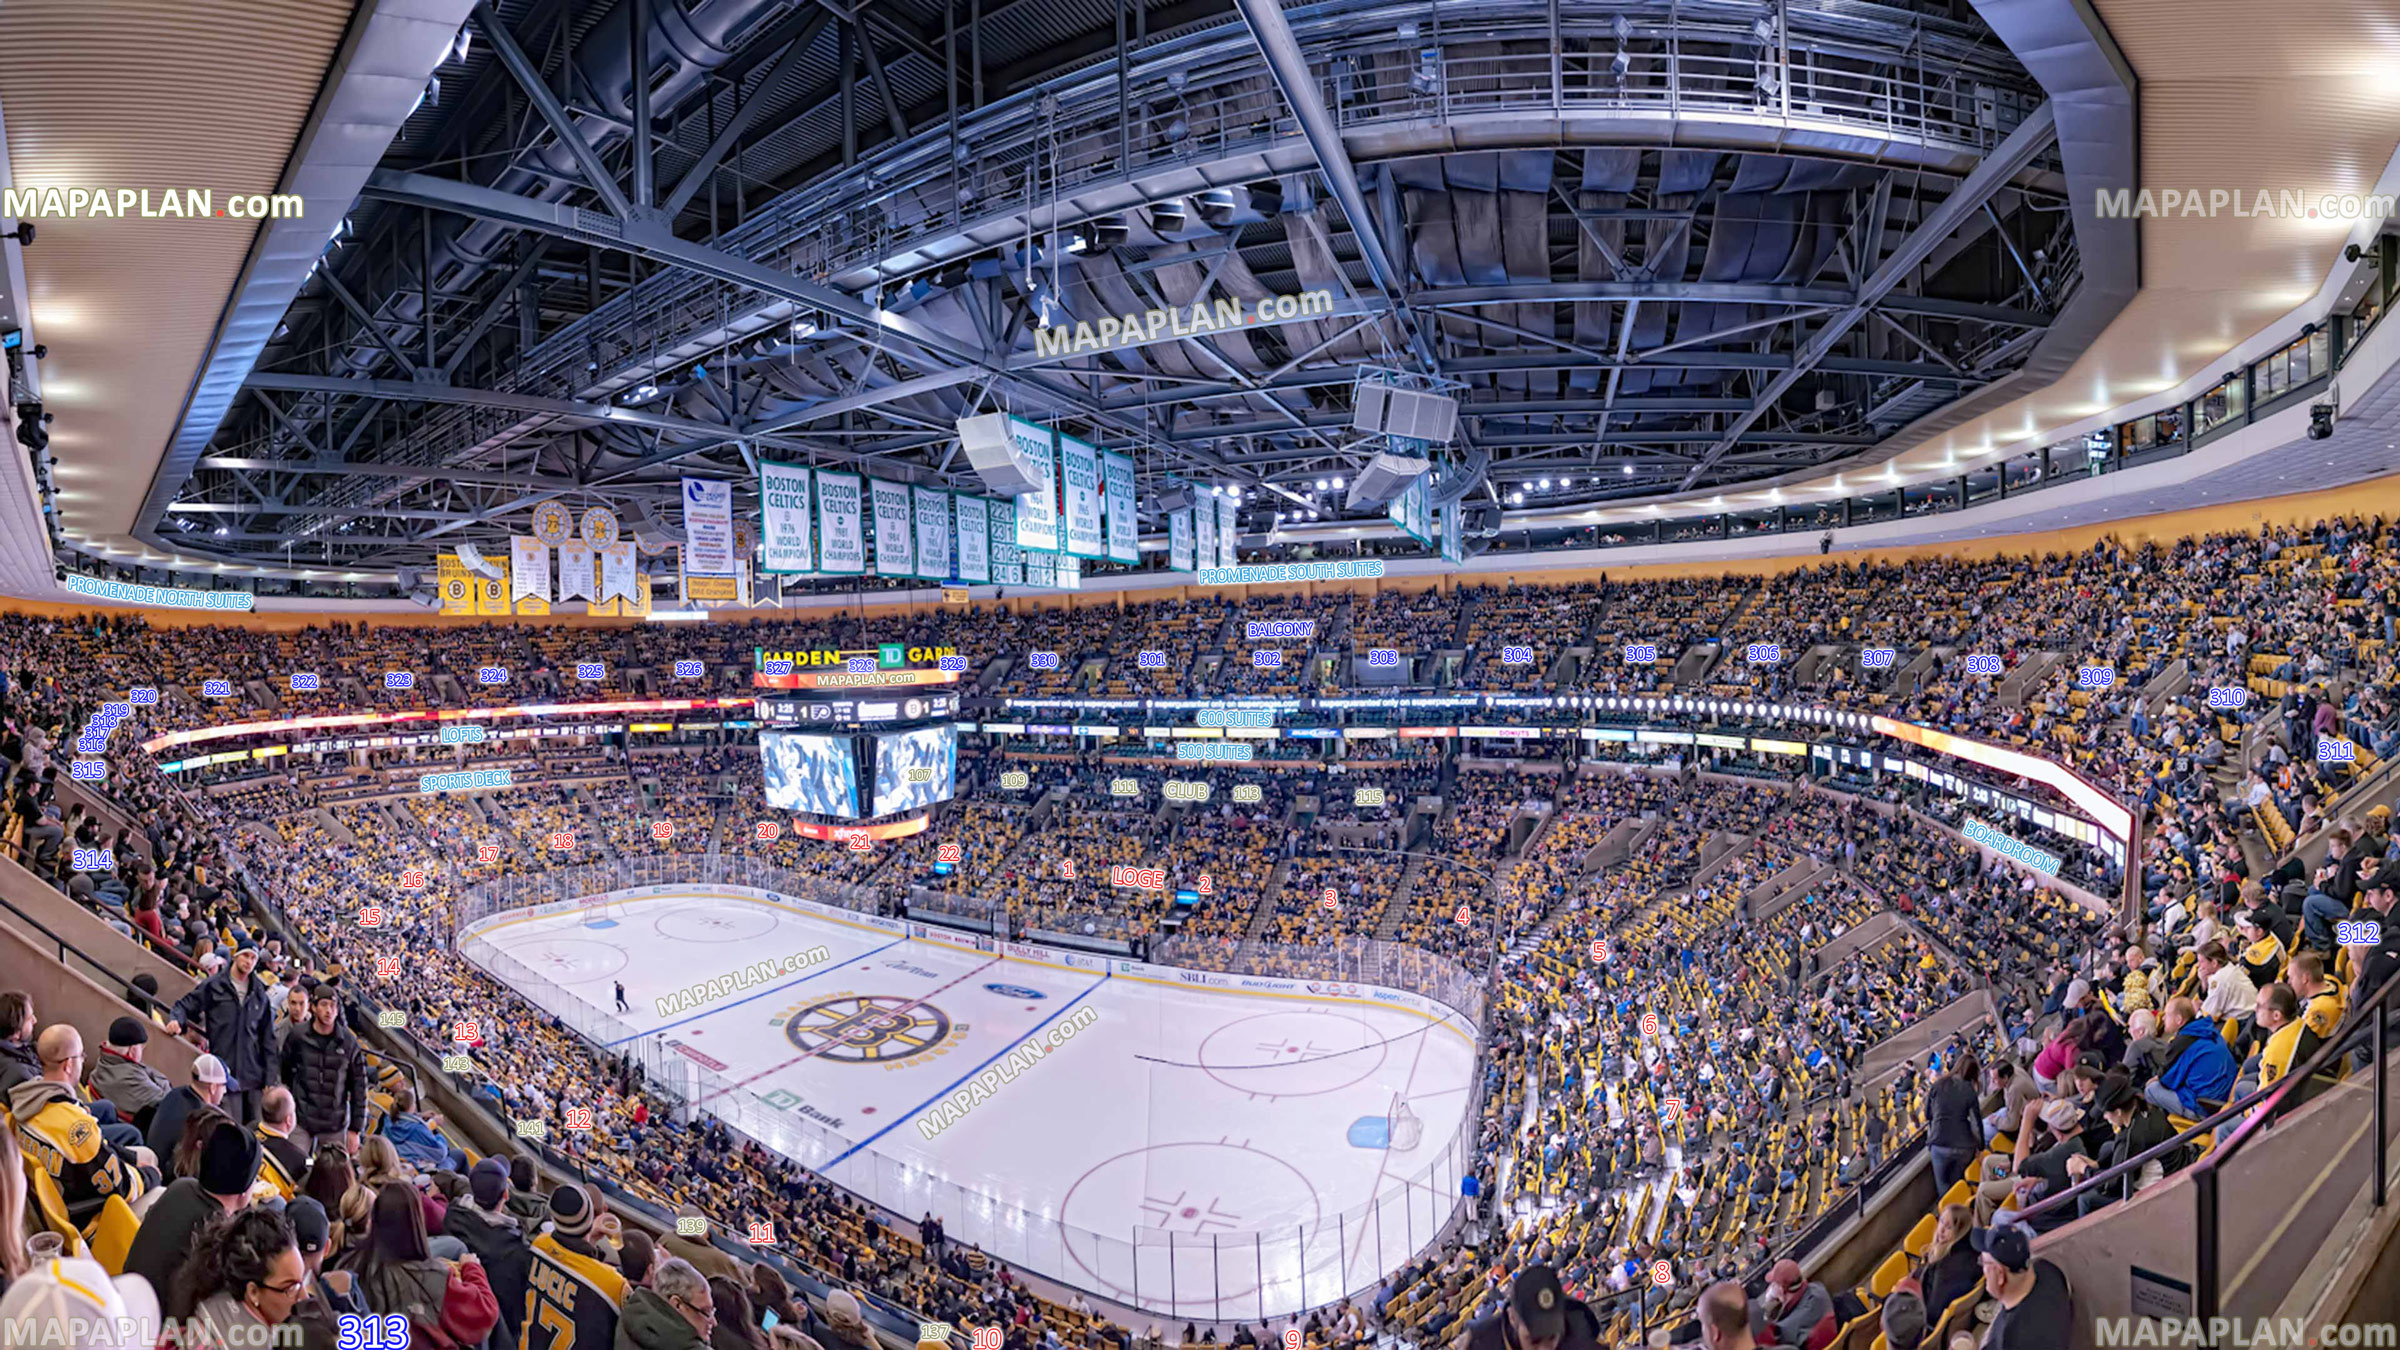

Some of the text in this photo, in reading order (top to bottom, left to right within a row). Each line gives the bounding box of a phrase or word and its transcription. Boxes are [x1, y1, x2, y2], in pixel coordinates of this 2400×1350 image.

[1016, 435, 1050, 460] BOSTON
[1065, 451, 1095, 473] BOSTON
[1067, 468, 1096, 491] CELTICS
[1107, 464, 1132, 484] BOSTON
[766, 475, 806, 493] BOSTON
[822, 483, 857, 499] BOSTON
[1109, 481, 1133, 500] CELTICS
[768, 493, 805, 509] CELTICS
[824, 499, 857, 515] CELTICS
[875, 490, 906, 506] BOSTON
[878, 505, 906, 521] CELTICS
[1026, 506, 1048, 521] WORLD
[776, 536, 802, 546] WORLD
[1179, 972, 1229, 987] SBLI.com
[798, 1105, 845, 1130] Bank
[91, 1153, 122, 1195] 37
[528, 1256, 578, 1312] LUCIC
[518, 1288, 576, 1350] 17
